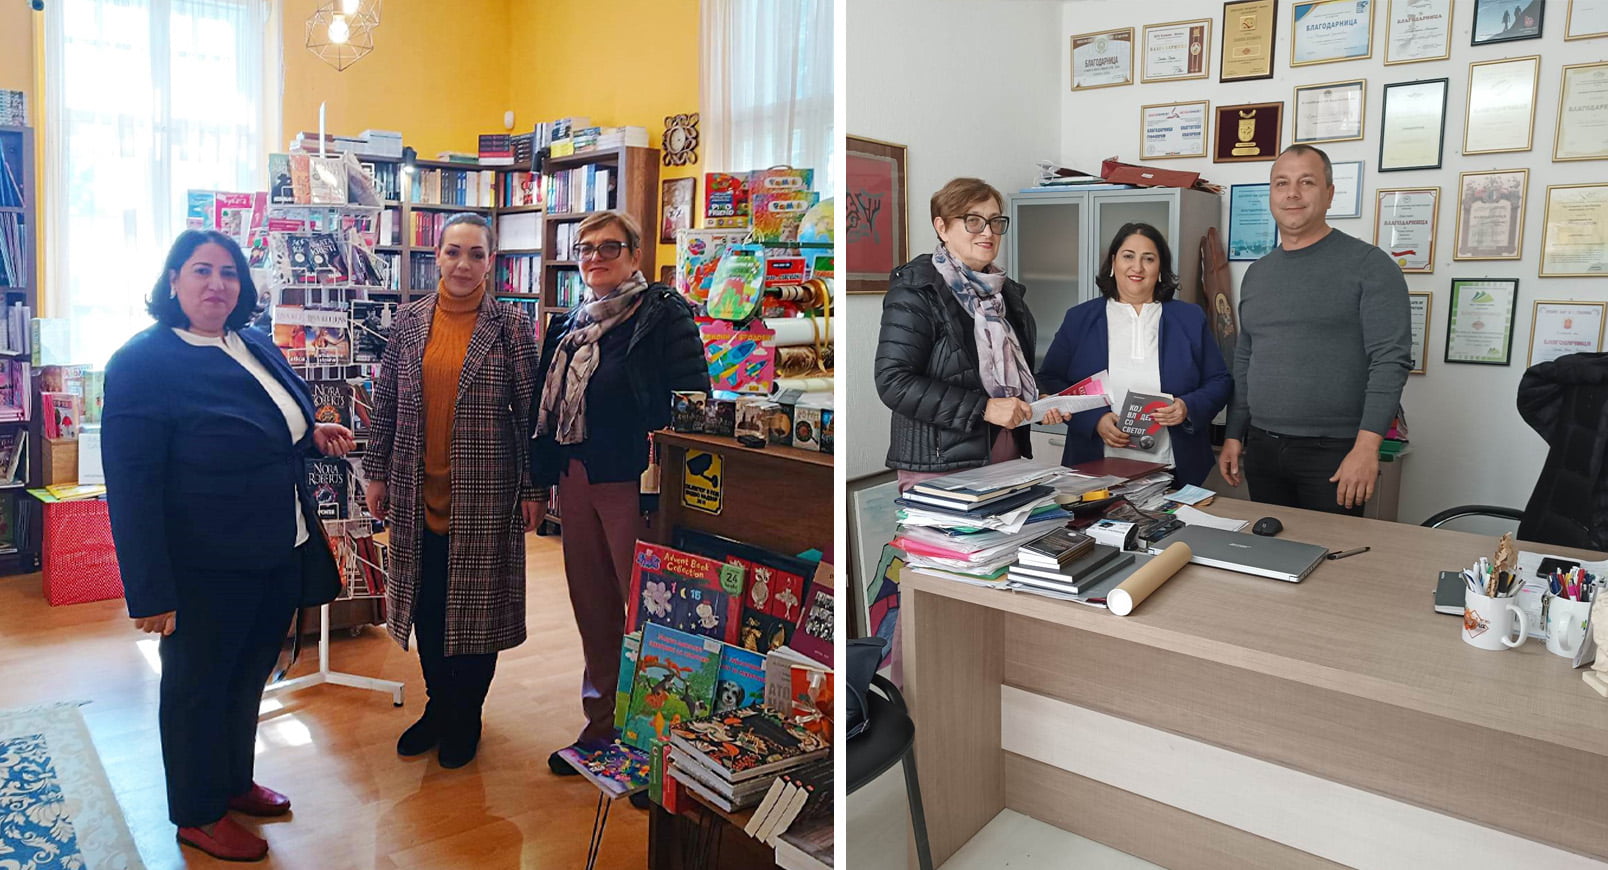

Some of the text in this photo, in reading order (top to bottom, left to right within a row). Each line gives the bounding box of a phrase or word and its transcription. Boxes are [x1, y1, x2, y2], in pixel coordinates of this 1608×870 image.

[1306, 18, 1358, 32] БЛАГОДАРНИЦА
[314, 384, 341, 398] NORA
[1129, 404, 1143, 412] КОЈ
[1124, 418, 1134, 426] СО
[1122, 426, 1146, 435] СВЕТОТ
[313, 462, 340, 475] NORA
[308, 472, 344, 486] ROBERTS
[663, 552, 689, 567] Advent
[690, 559, 710, 572] Book
[666, 561, 704, 578] Collection
